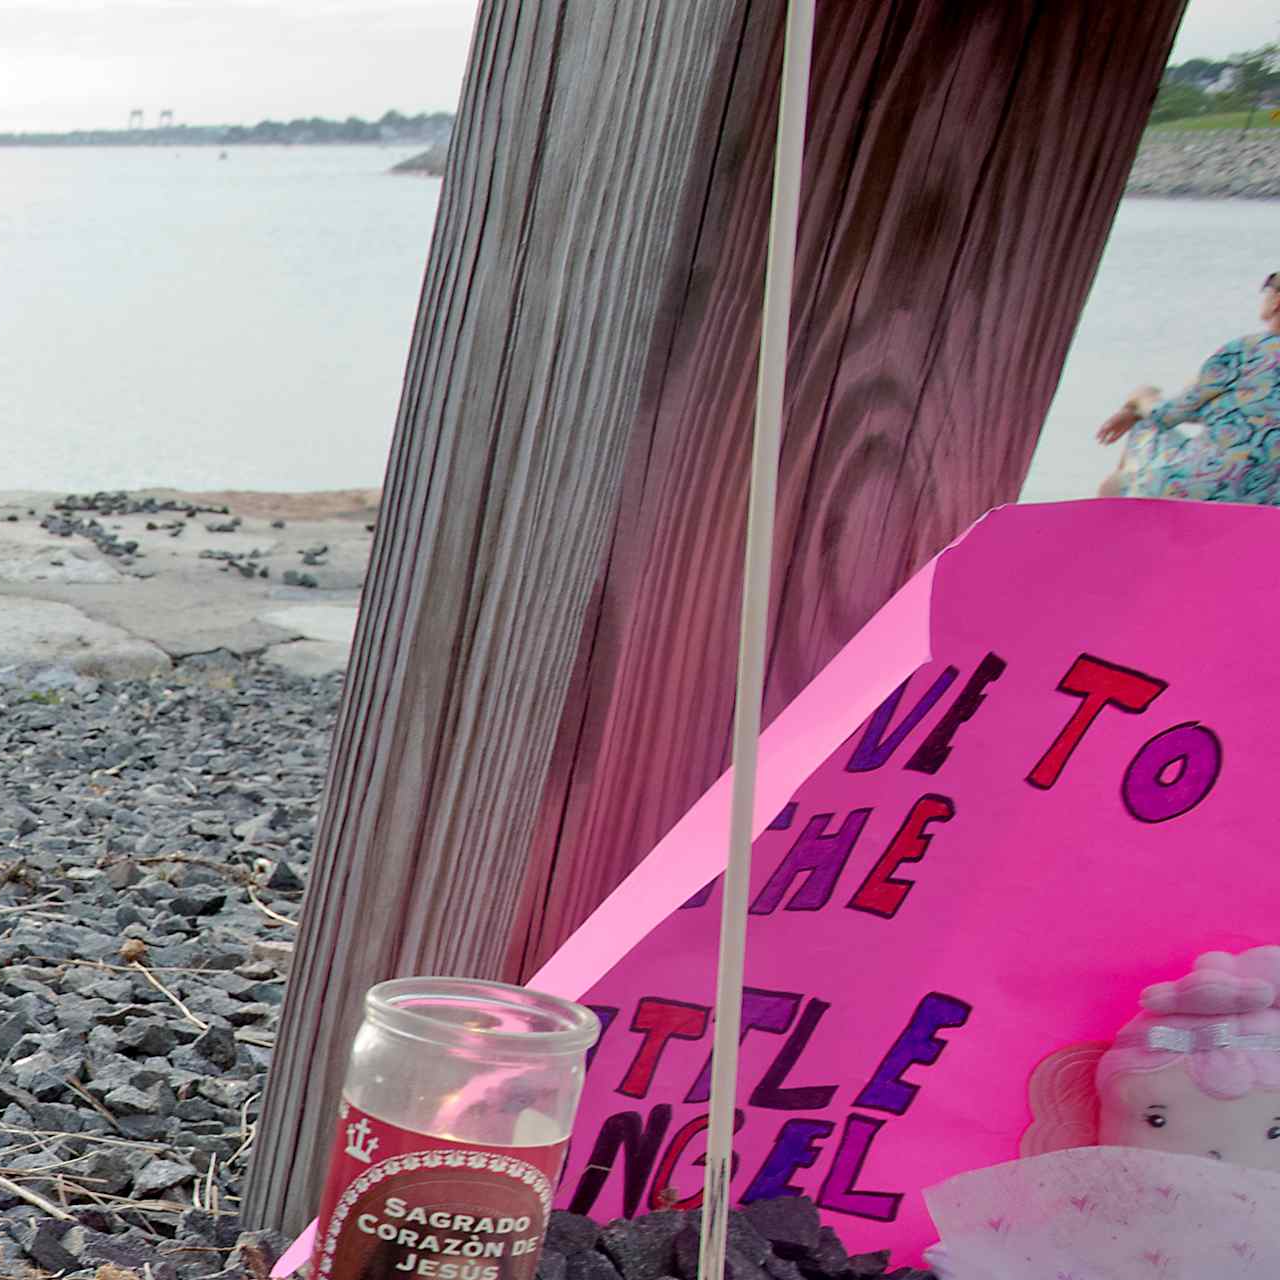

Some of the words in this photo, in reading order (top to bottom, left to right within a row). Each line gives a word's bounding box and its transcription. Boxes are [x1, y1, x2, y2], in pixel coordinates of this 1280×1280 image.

[844, 651, 1008, 776] VE
[1025, 651, 1224, 825] TO
[583, 986, 974, 1117] TTLE
[383, 1197, 532, 1235] SAGRADO
[557, 1103, 905, 1222] NGEL
[511, 1235, 540, 1257] DE
